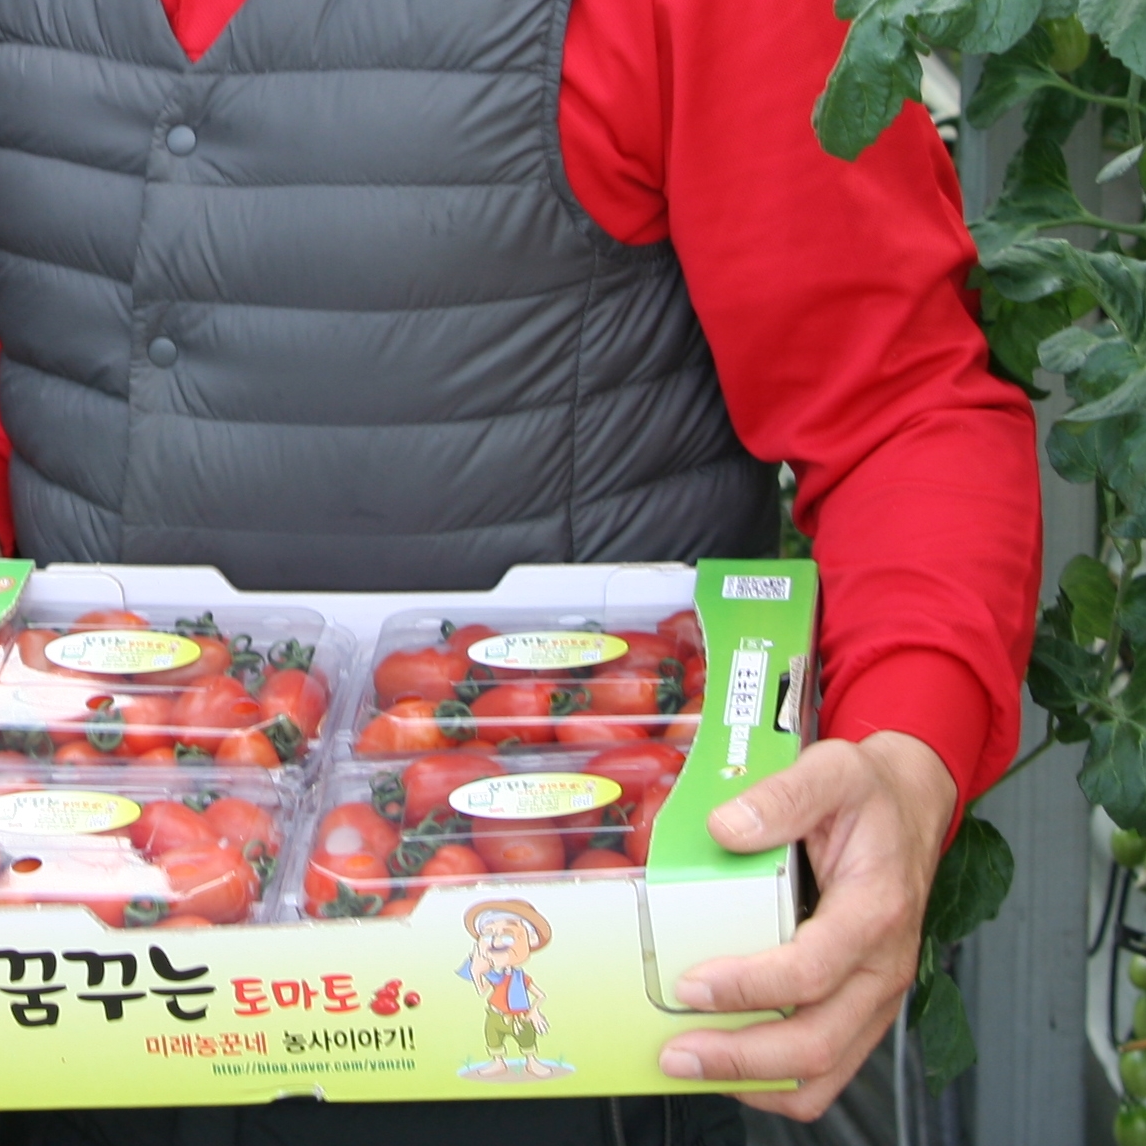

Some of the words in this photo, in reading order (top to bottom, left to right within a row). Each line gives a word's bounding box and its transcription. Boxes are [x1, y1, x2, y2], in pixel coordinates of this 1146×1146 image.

[230, 974, 361, 1017] 토마토
[145, 1032, 269, 1058] 미래농꾼네
[283, 1026, 417, 1054] 농사이야기!
